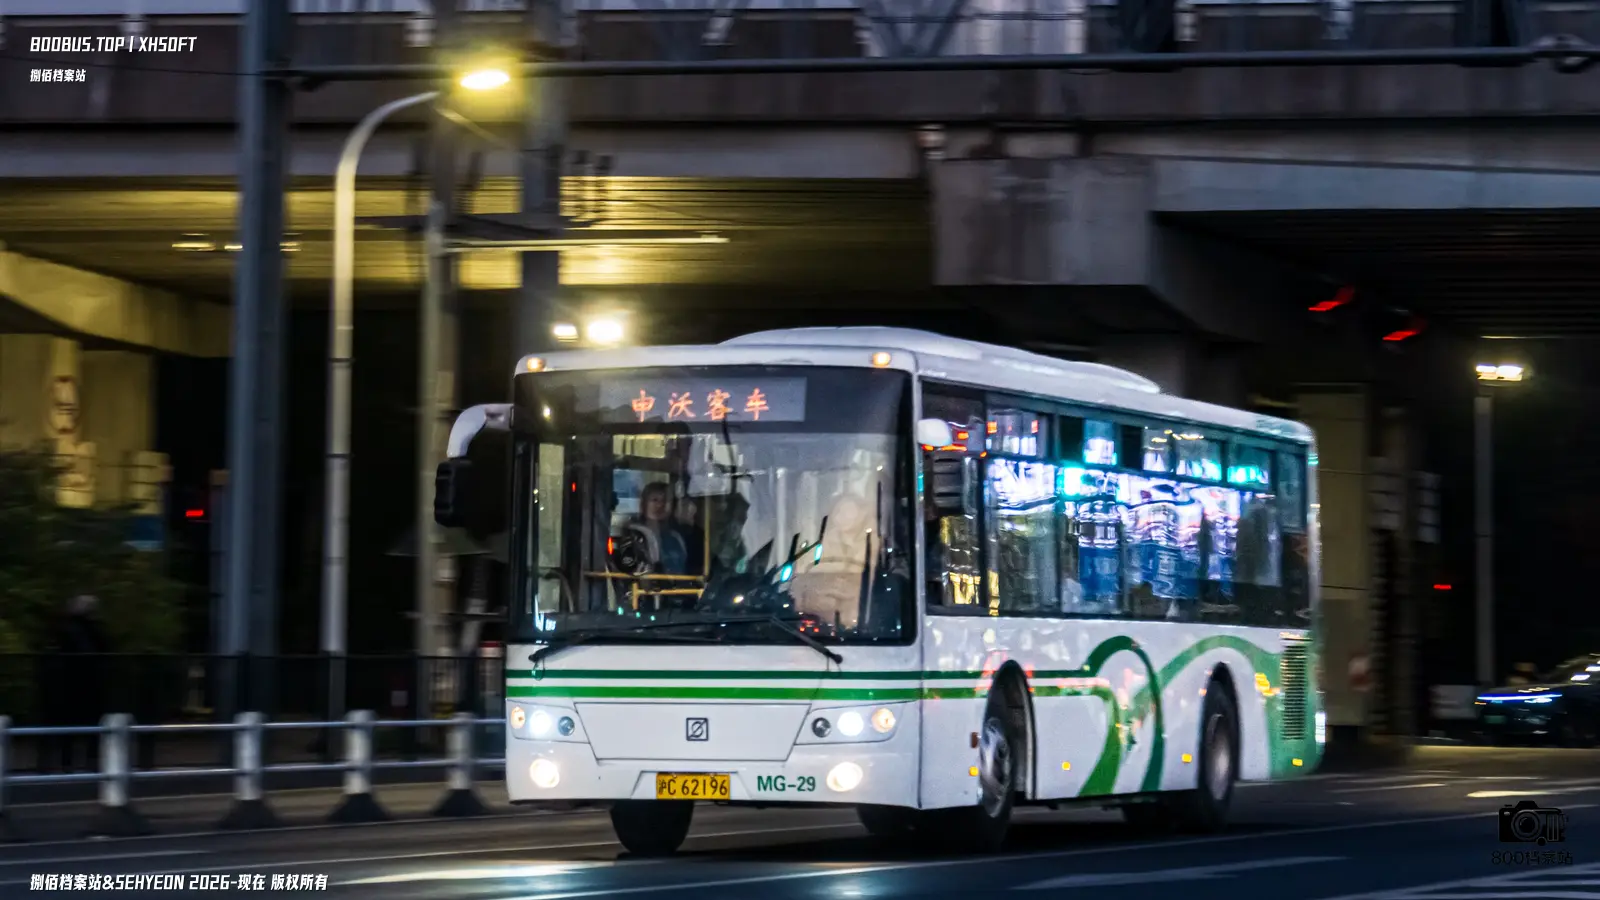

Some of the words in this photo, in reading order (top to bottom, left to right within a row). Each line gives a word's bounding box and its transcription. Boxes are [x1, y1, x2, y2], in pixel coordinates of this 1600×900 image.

[631, 387, 769, 422] 申沃客车
[681, 779, 728, 795] 62196
[756, 775, 816, 792] MG-29
